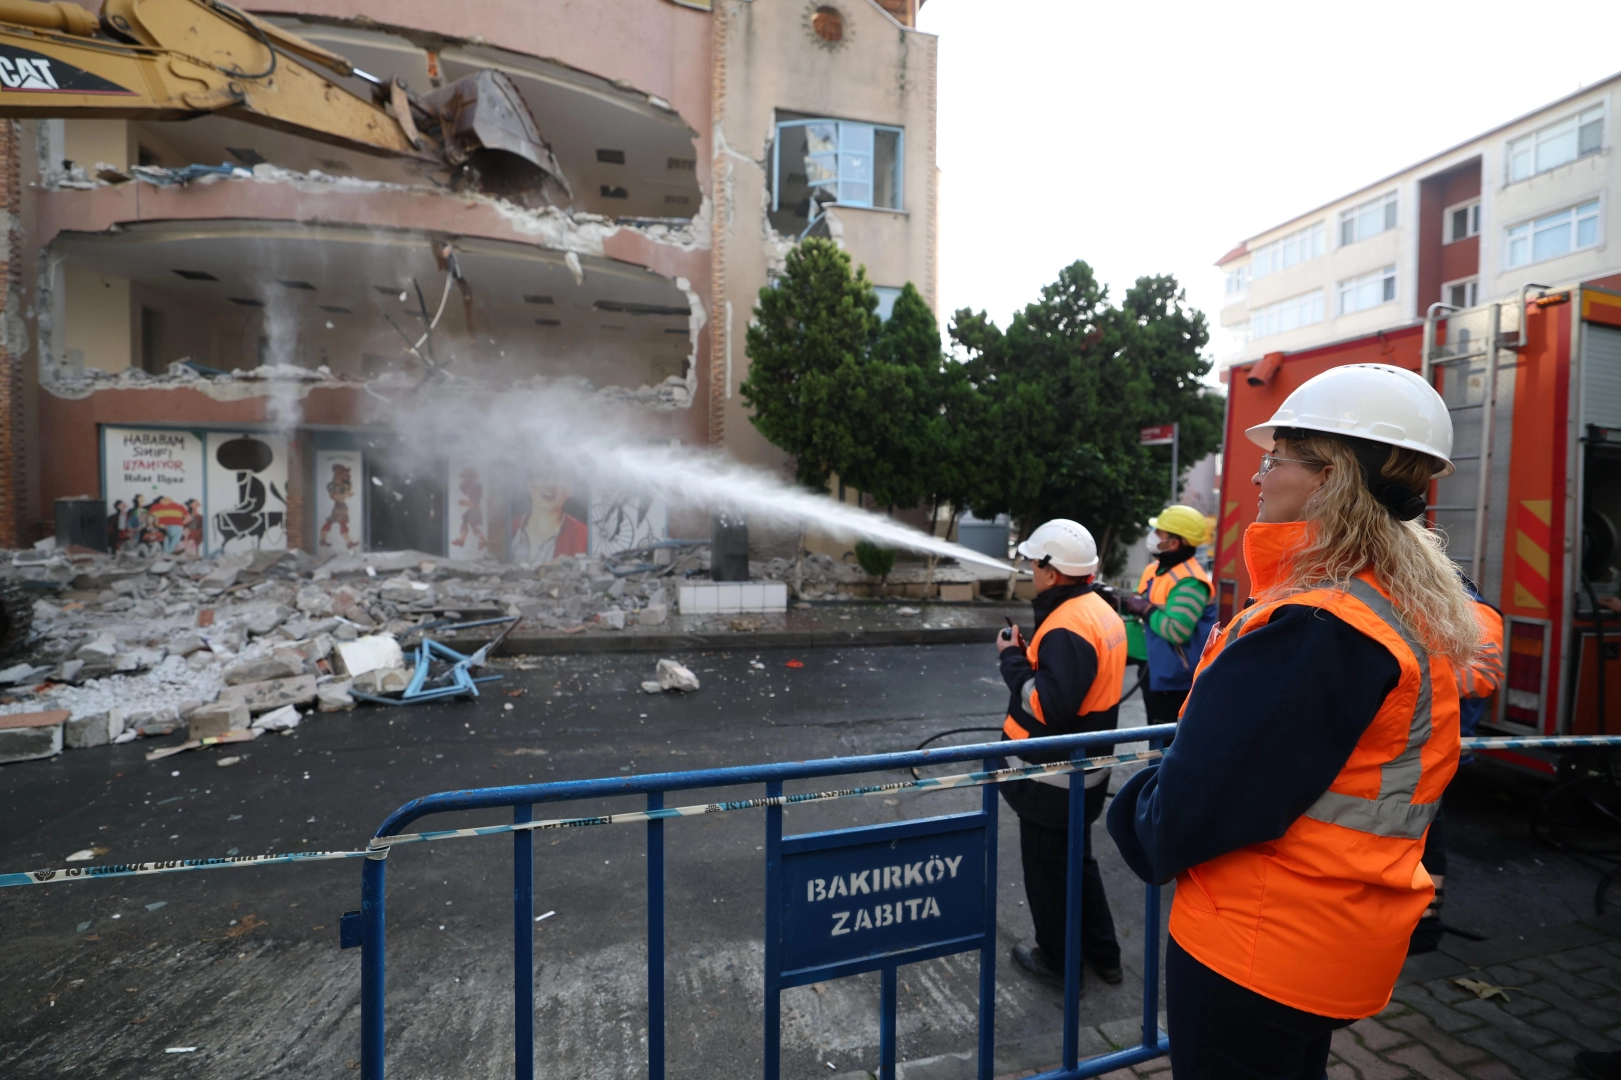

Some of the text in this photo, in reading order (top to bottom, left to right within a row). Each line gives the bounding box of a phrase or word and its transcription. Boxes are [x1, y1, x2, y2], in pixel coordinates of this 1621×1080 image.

[0, 56, 60, 89] CAT
[123, 433, 185, 450] HABABAM
[122, 460, 186, 473] UYANIYOR
[807, 855, 963, 902] BAKIRKÖY
[831, 896, 941, 936] ZABITA
